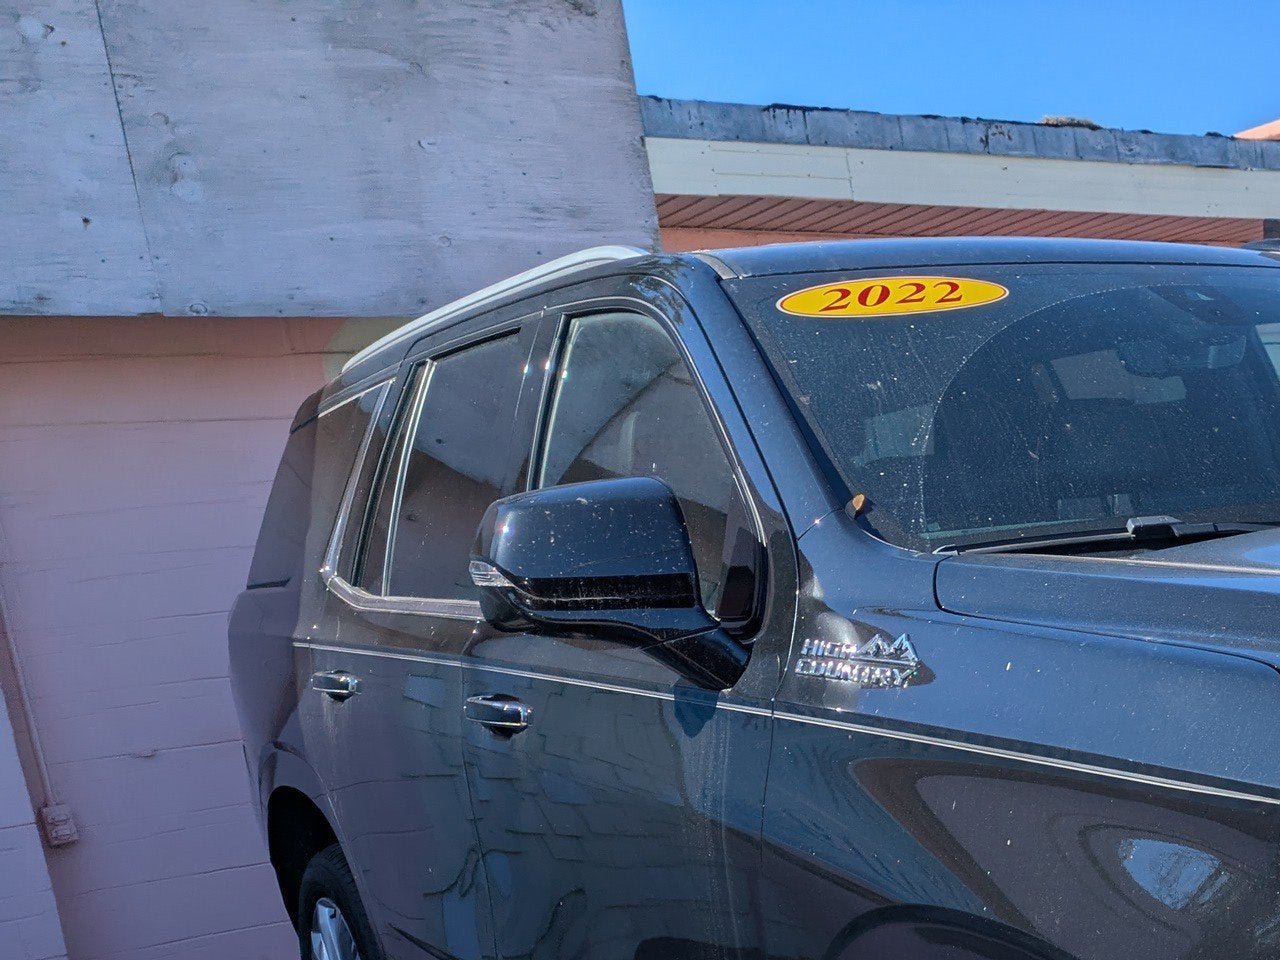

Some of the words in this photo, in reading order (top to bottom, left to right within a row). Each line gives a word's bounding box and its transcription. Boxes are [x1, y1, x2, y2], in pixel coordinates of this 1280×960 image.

[819, 281, 963, 312] 2022
[801, 638, 858, 660] HIGH
[795, 658, 918, 689] COUNTRY
